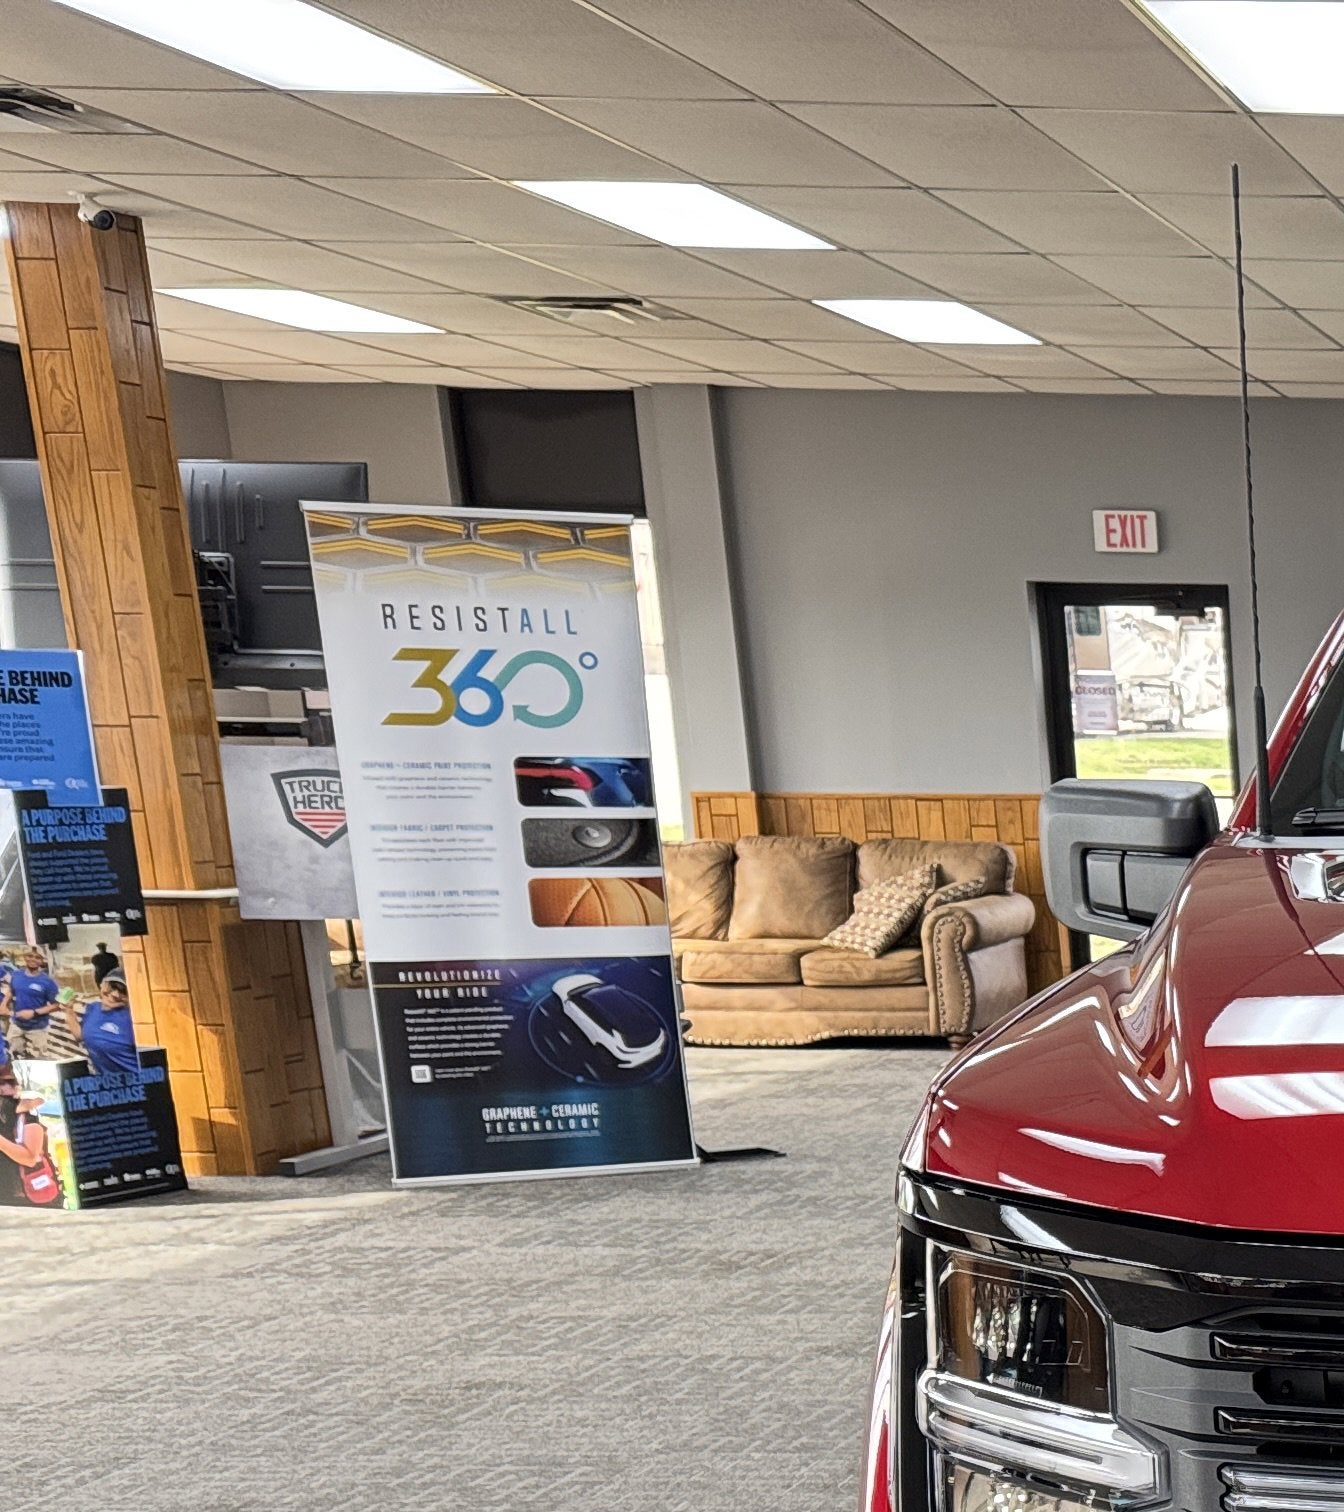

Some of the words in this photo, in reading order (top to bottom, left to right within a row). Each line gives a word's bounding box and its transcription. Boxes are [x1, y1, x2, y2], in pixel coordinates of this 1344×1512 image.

[1104, 514, 1147, 548] EXIT
[381, 603, 578, 635] RESISTALL
[8, 670, 73, 688] BEHIND
[21, 809, 31, 826] A
[31, 808, 84, 826] PURPOSE
[85, 807, 127, 824] BEHIND
[23, 826, 47, 844] THE
[47, 825, 108, 843] PURCHASE
[399, 969, 500, 982] REVOLUTIONIZE
[416, 987, 449, 999] YOUR
[457, 986, 488, 998] RIDE
[63, 1079, 72, 1095] A
[72, 1072, 124, 1095] PURPOSE
[65, 1094, 88, 1112] THE
[88, 1085, 147, 1108] PURCHASE
[482, 1105, 537, 1121] GRAPHENE
[552, 1102, 600, 1117] CERAMIC
[485, 1117, 599, 1134] TECHNOLOGY
